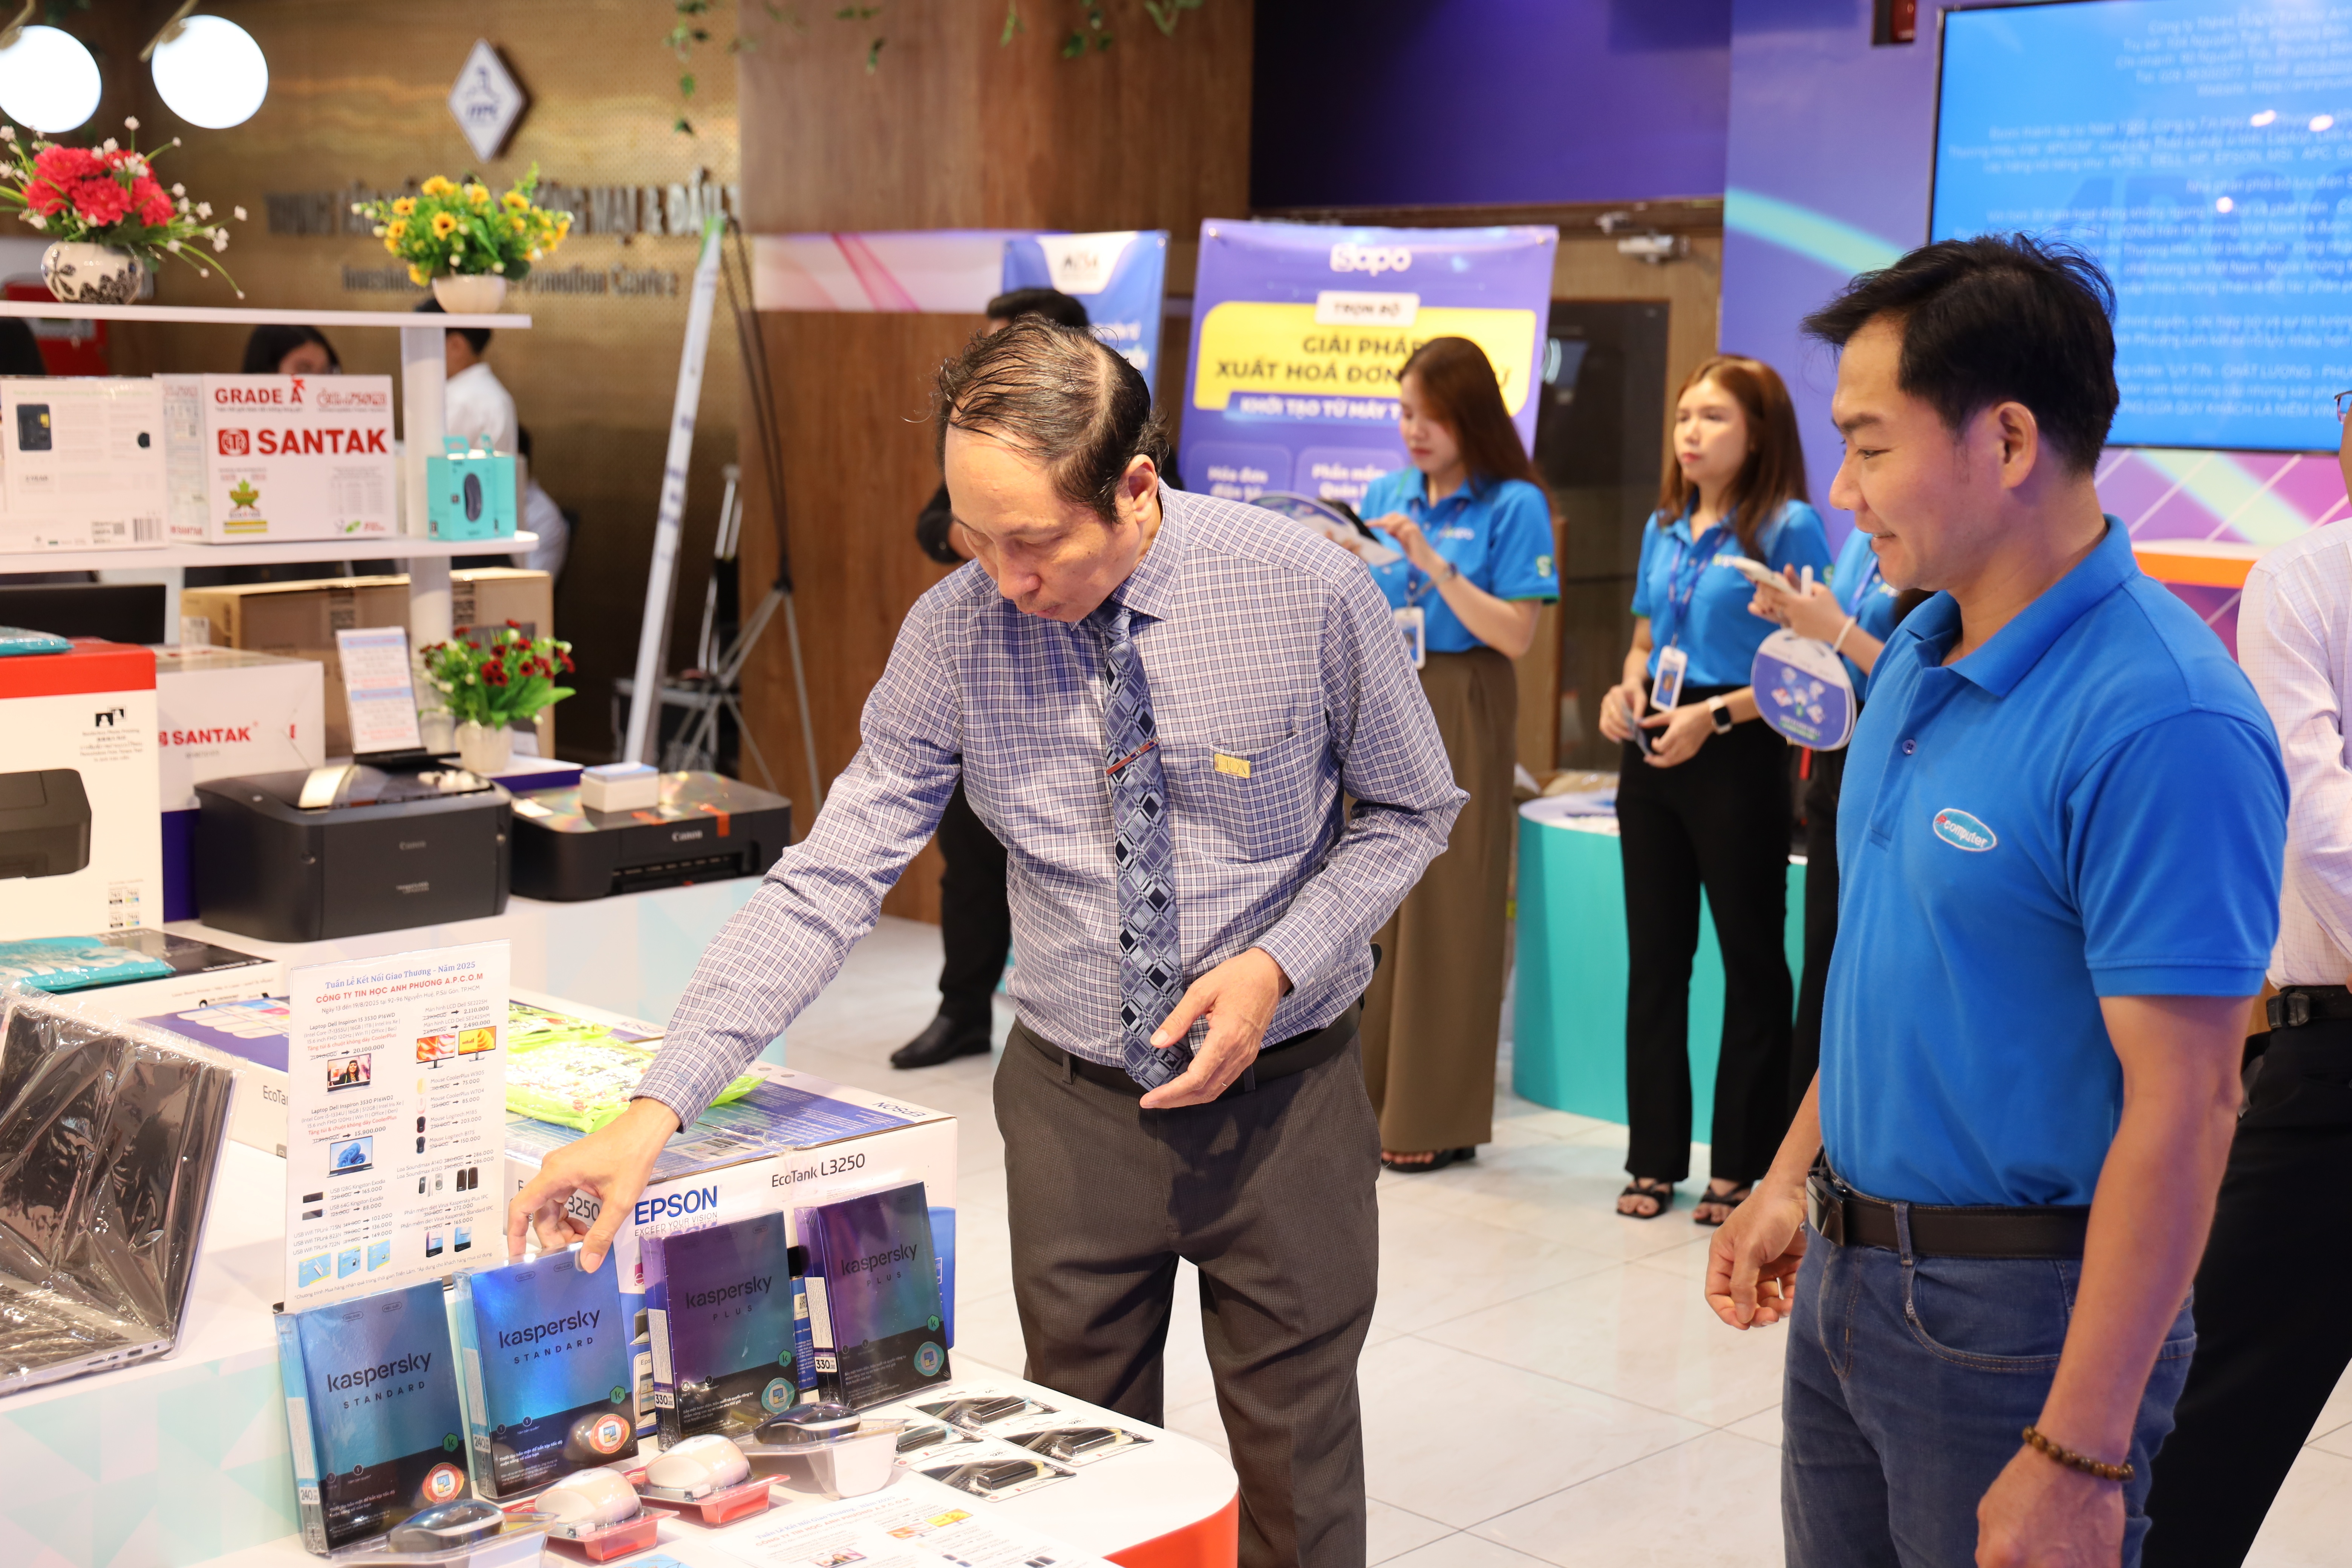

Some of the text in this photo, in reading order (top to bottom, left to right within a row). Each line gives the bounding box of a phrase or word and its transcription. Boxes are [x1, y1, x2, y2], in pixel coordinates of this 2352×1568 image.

[1303, 331, 1349, 354] GIẢI
[1216, 355, 1278, 378] XUẤT
[1286, 360, 1338, 381] HOÁ
[215, 388, 283, 404] GRADE
[290, 386, 303, 404] A
[258, 428, 388, 455] SANTAK
[172, 727, 251, 746] SANTAK
[672, 830, 703, 842] Canon
[325, 978, 345, 989] Tuần
[346, 975, 355, 986] Lễ
[356, 974, 369, 985] Kết
[371, 972, 384, 983] Nối
[385, 972, 403, 980] Giao
[403, 968, 431, 978] Thương
[438, 964, 455, 973] Năm
[456, 961, 475, 970] 2025
[316, 993, 341, 1003] CÔNG
[369, 986, 387, 996] HỌC
[390, 984, 407, 993] ANH
[409, 978, 443, 989] PHƯƠNG
[444, 972, 483, 985] A.P.C.O.M
[352, 999, 379, 1009] 19/8/2025
[403, 992, 423, 1003] Nguyễn
[464, 1005, 489, 1014] 2.110.000
[338, 1019, 357, 1027] Inspiron
[463, 1019, 490, 1028] 2.490.000
[465, 1013, 490, 1021] SE2425HM
[353, 1044, 384, 1054] 20.100.000
[446, 1072, 470, 1081] CoolerPlus
[873, 1101, 926, 1118] EPSON
[354, 1126, 386, 1136] 15.900.000
[772, 1153, 865, 1188] EcoTank L3250
[362, 1185, 382, 1194] 165.000
[371, 1178, 386, 1187] Exodia
[635, 1185, 718, 1225] EPSON
[400, 1222, 412, 1230] Phần
[412, 1219, 425, 1228] mềm
[424, 1218, 433, 1226] diệt
[445, 1211, 466, 1222] Kaspersky
[466, 1206, 485, 1217] Standard
[453, 1216, 473, 1225] 165.000
[635, 1211, 717, 1236] EXCEED YOUR VISION
[842, 1243, 918, 1276] kaspersky
[867, 1271, 901, 1286] PLUS
[686, 1275, 773, 1309] kaspersky
[713, 1305, 752, 1321] PLUS
[499, 1309, 600, 1349] kaspersky
[514, 1337, 594, 1364] STANDARD
[328, 1352, 432, 1392] kaspersky
[343, 1380, 426, 1409] STANDARD
[929, 1444, 955, 1455] Kingston
